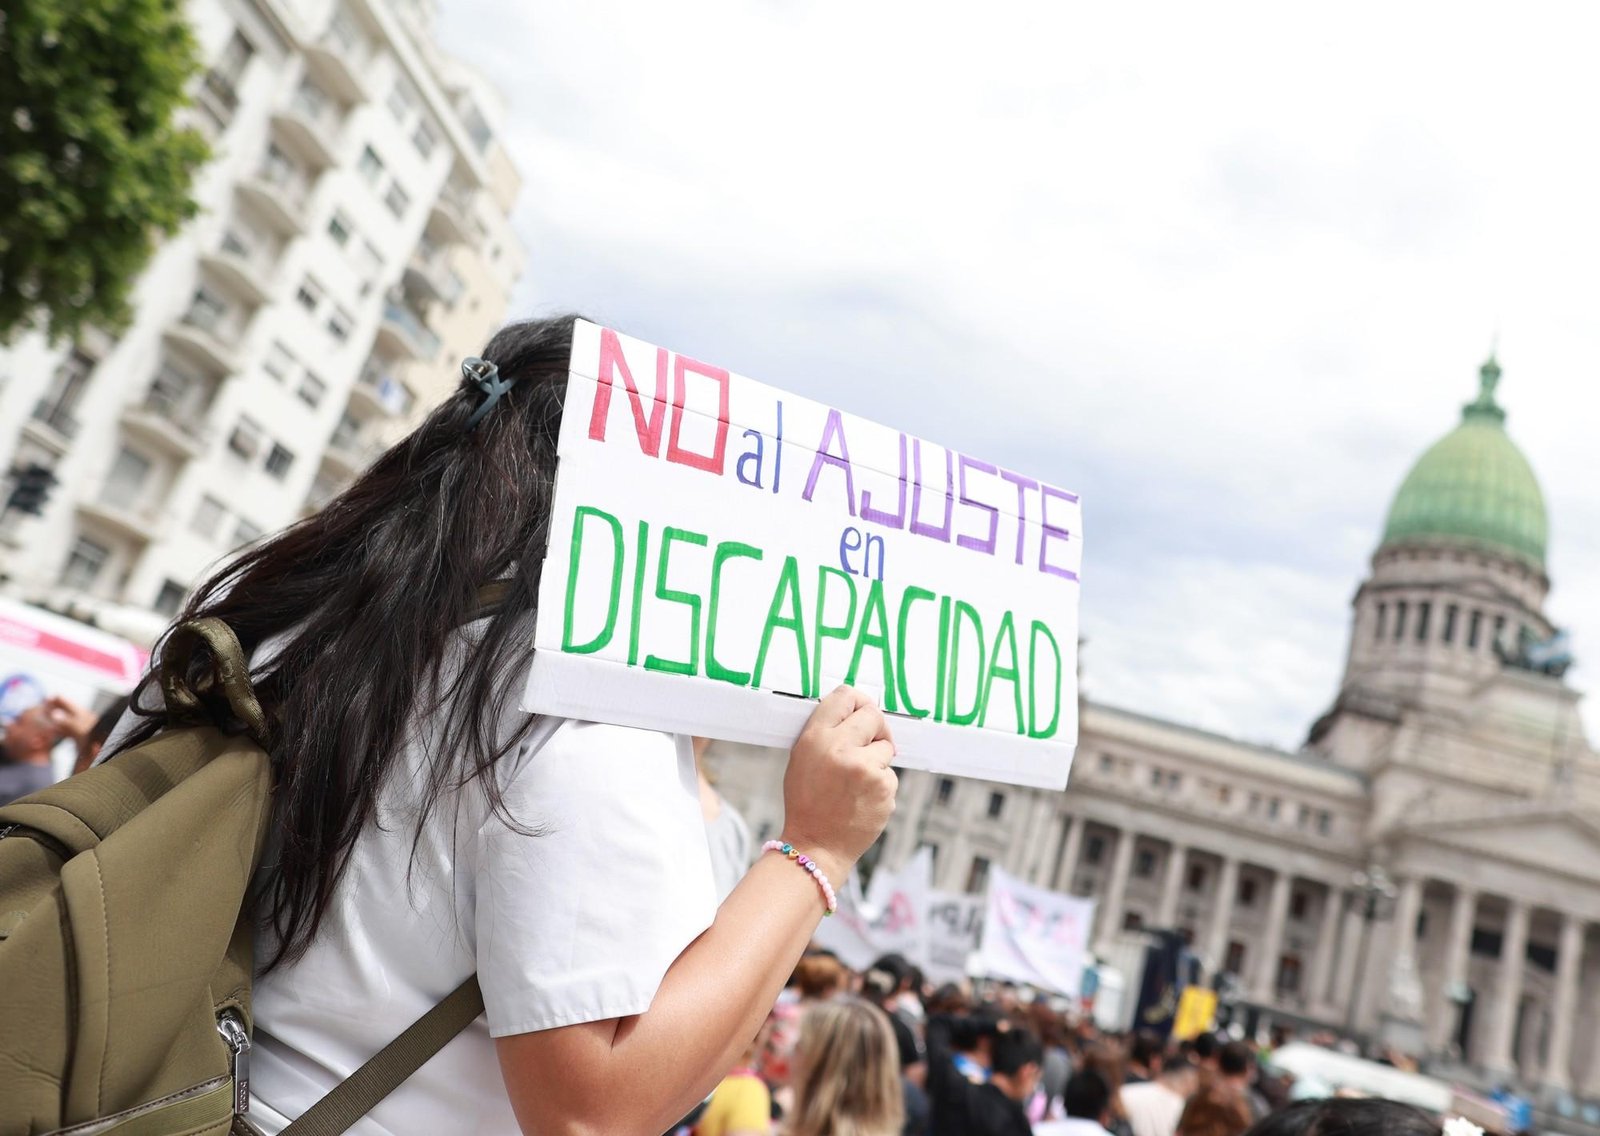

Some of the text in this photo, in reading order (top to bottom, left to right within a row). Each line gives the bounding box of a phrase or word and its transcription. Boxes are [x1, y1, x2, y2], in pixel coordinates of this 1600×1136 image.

[588, 328, 1080, 583] NO al AJUSTE
[839, 526, 885, 582] en
[561, 505, 1062, 740] DISCAPACIDAD
